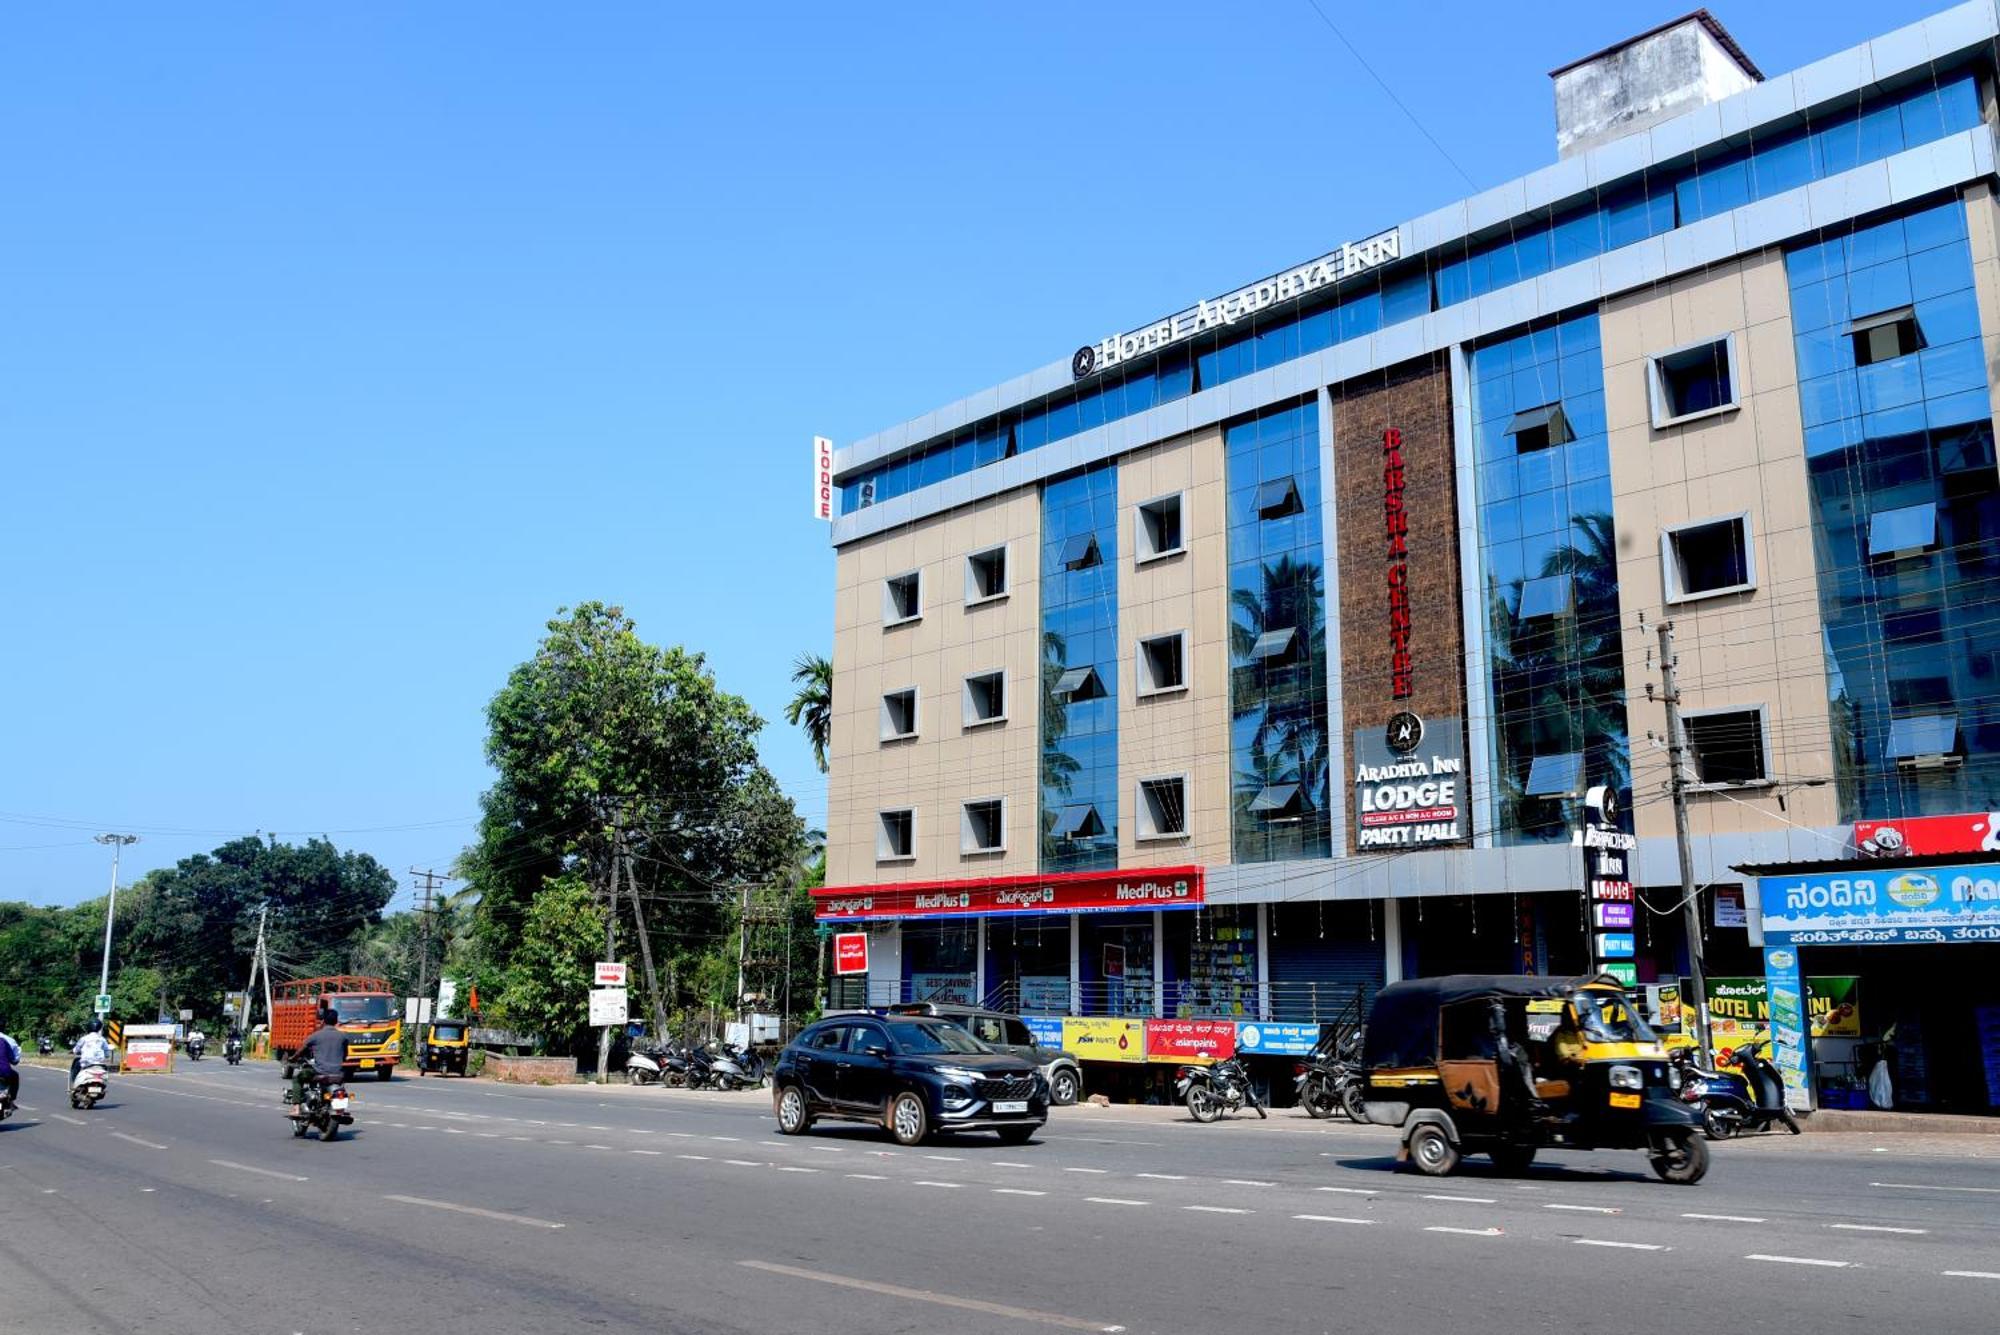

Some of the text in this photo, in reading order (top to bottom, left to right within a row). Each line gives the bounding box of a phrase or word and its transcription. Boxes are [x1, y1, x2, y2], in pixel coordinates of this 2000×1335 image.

[1101, 233, 1400, 370] HOTEL ARADHYA INN
[820, 440, 831, 518] LODGE
[1383, 428, 1413, 699] BARSHA CENTRE
[1356, 756, 1460, 782] ARADHYA INN
[1362, 781, 1455, 811] LODGE
[1432, 810, 1452, 818] ROOM
[1360, 823, 1460, 845] PARTY HALL
[915, 893, 958, 909] MedPlus
[1117, 882, 1172, 900] MedPlus
[1787, 879, 1877, 909] ನಂದಿನಿ
